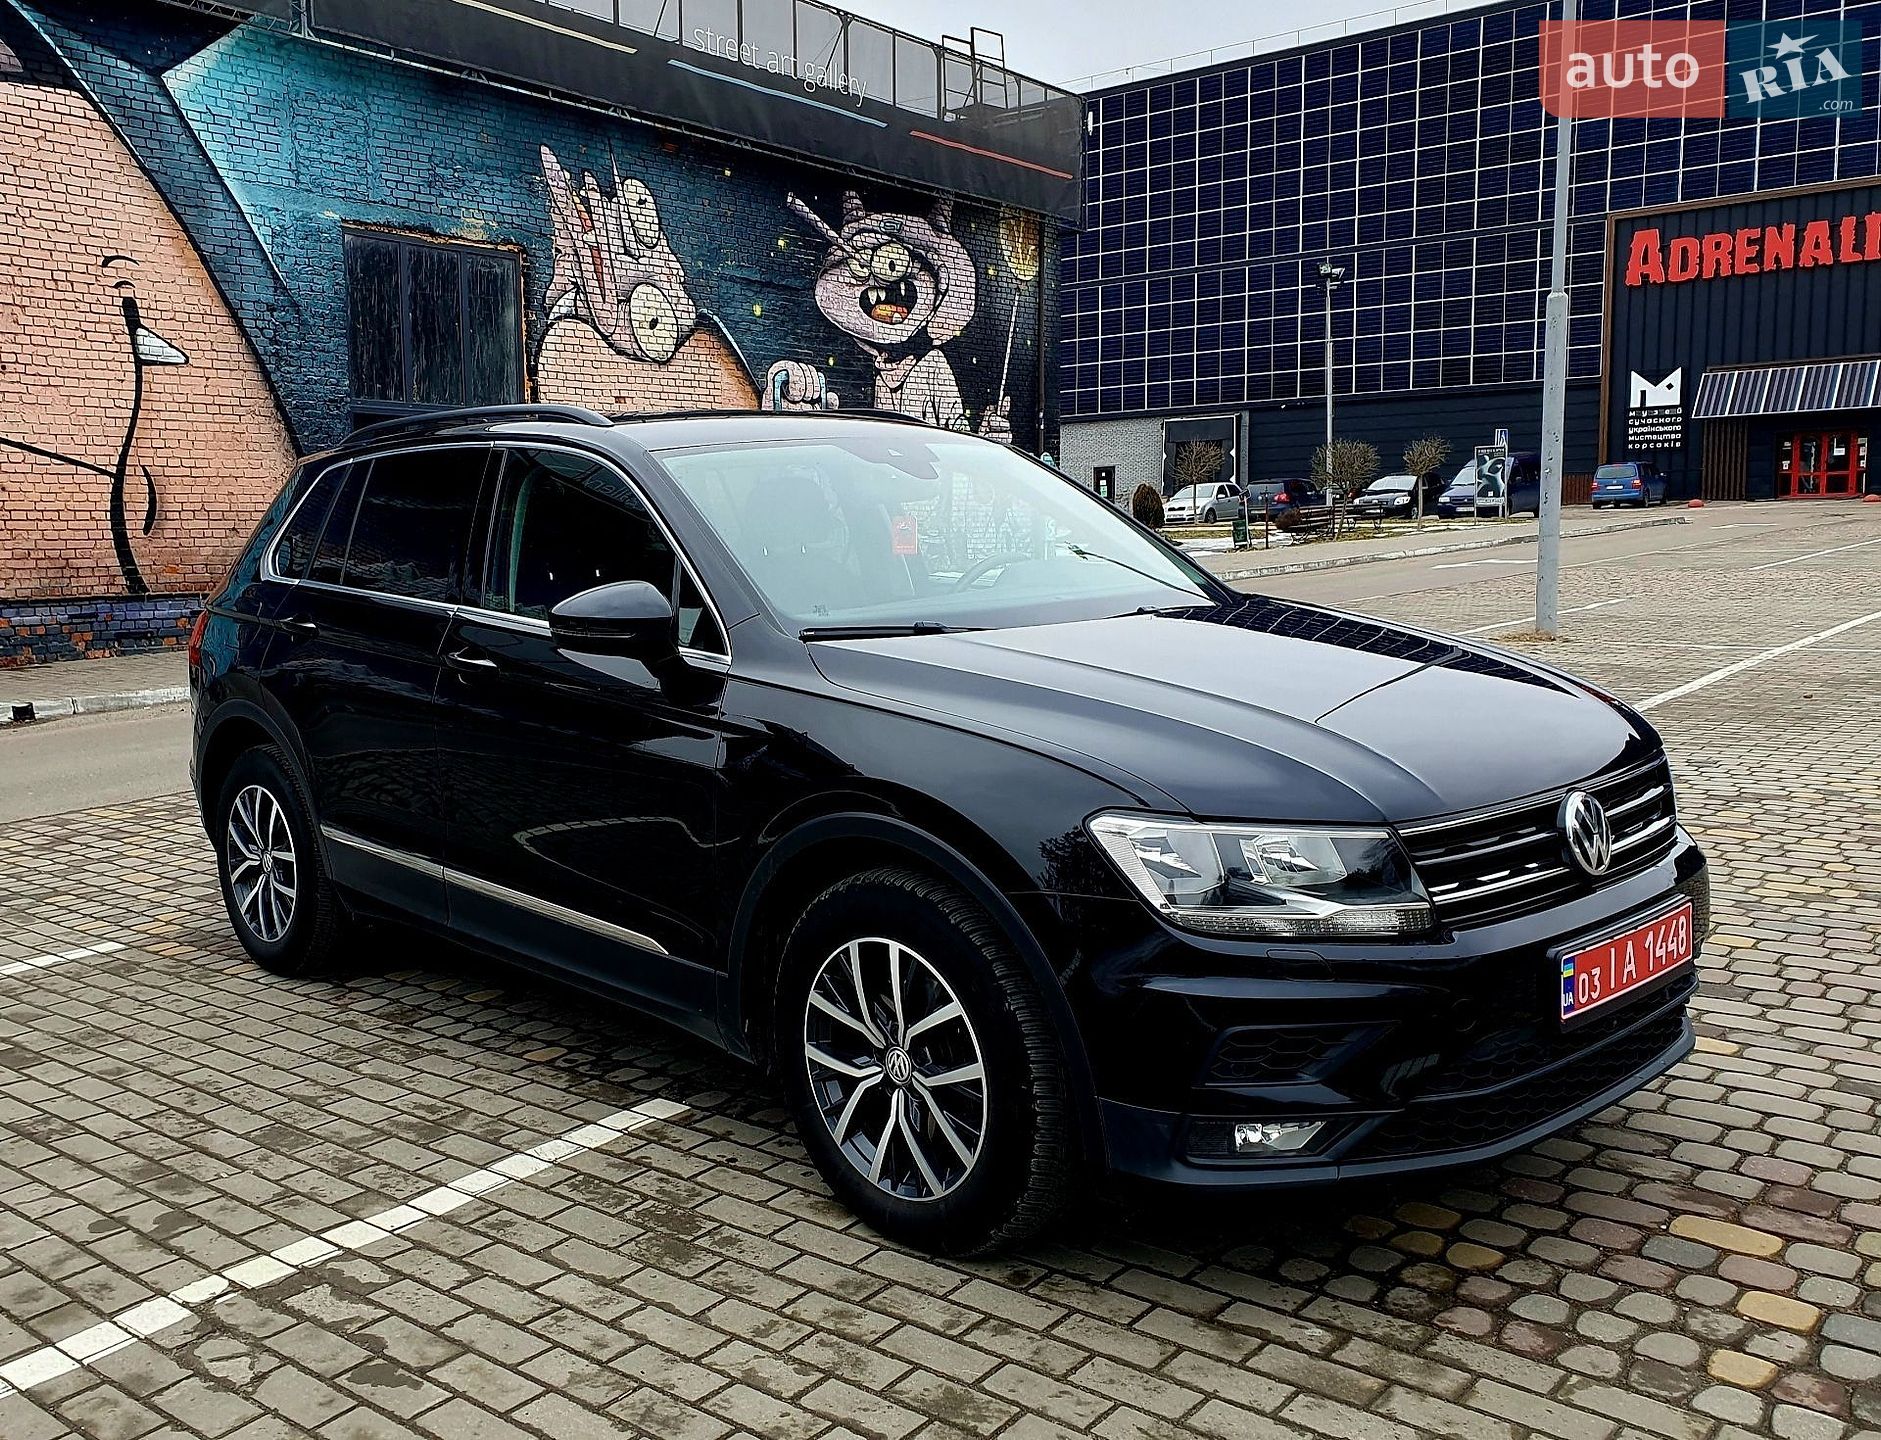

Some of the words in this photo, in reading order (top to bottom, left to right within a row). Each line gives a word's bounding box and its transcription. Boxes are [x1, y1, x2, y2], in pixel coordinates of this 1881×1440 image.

[693, 26, 761, 70] street
[766, 51, 799, 80] art
[803, 62, 867, 107] gallery
[1562, 992, 1575, 1007] UA
[1578, 966, 1601, 1004] 03
[1610, 940, 1637, 989] IA
[1645, 915, 1687, 972] 1448
